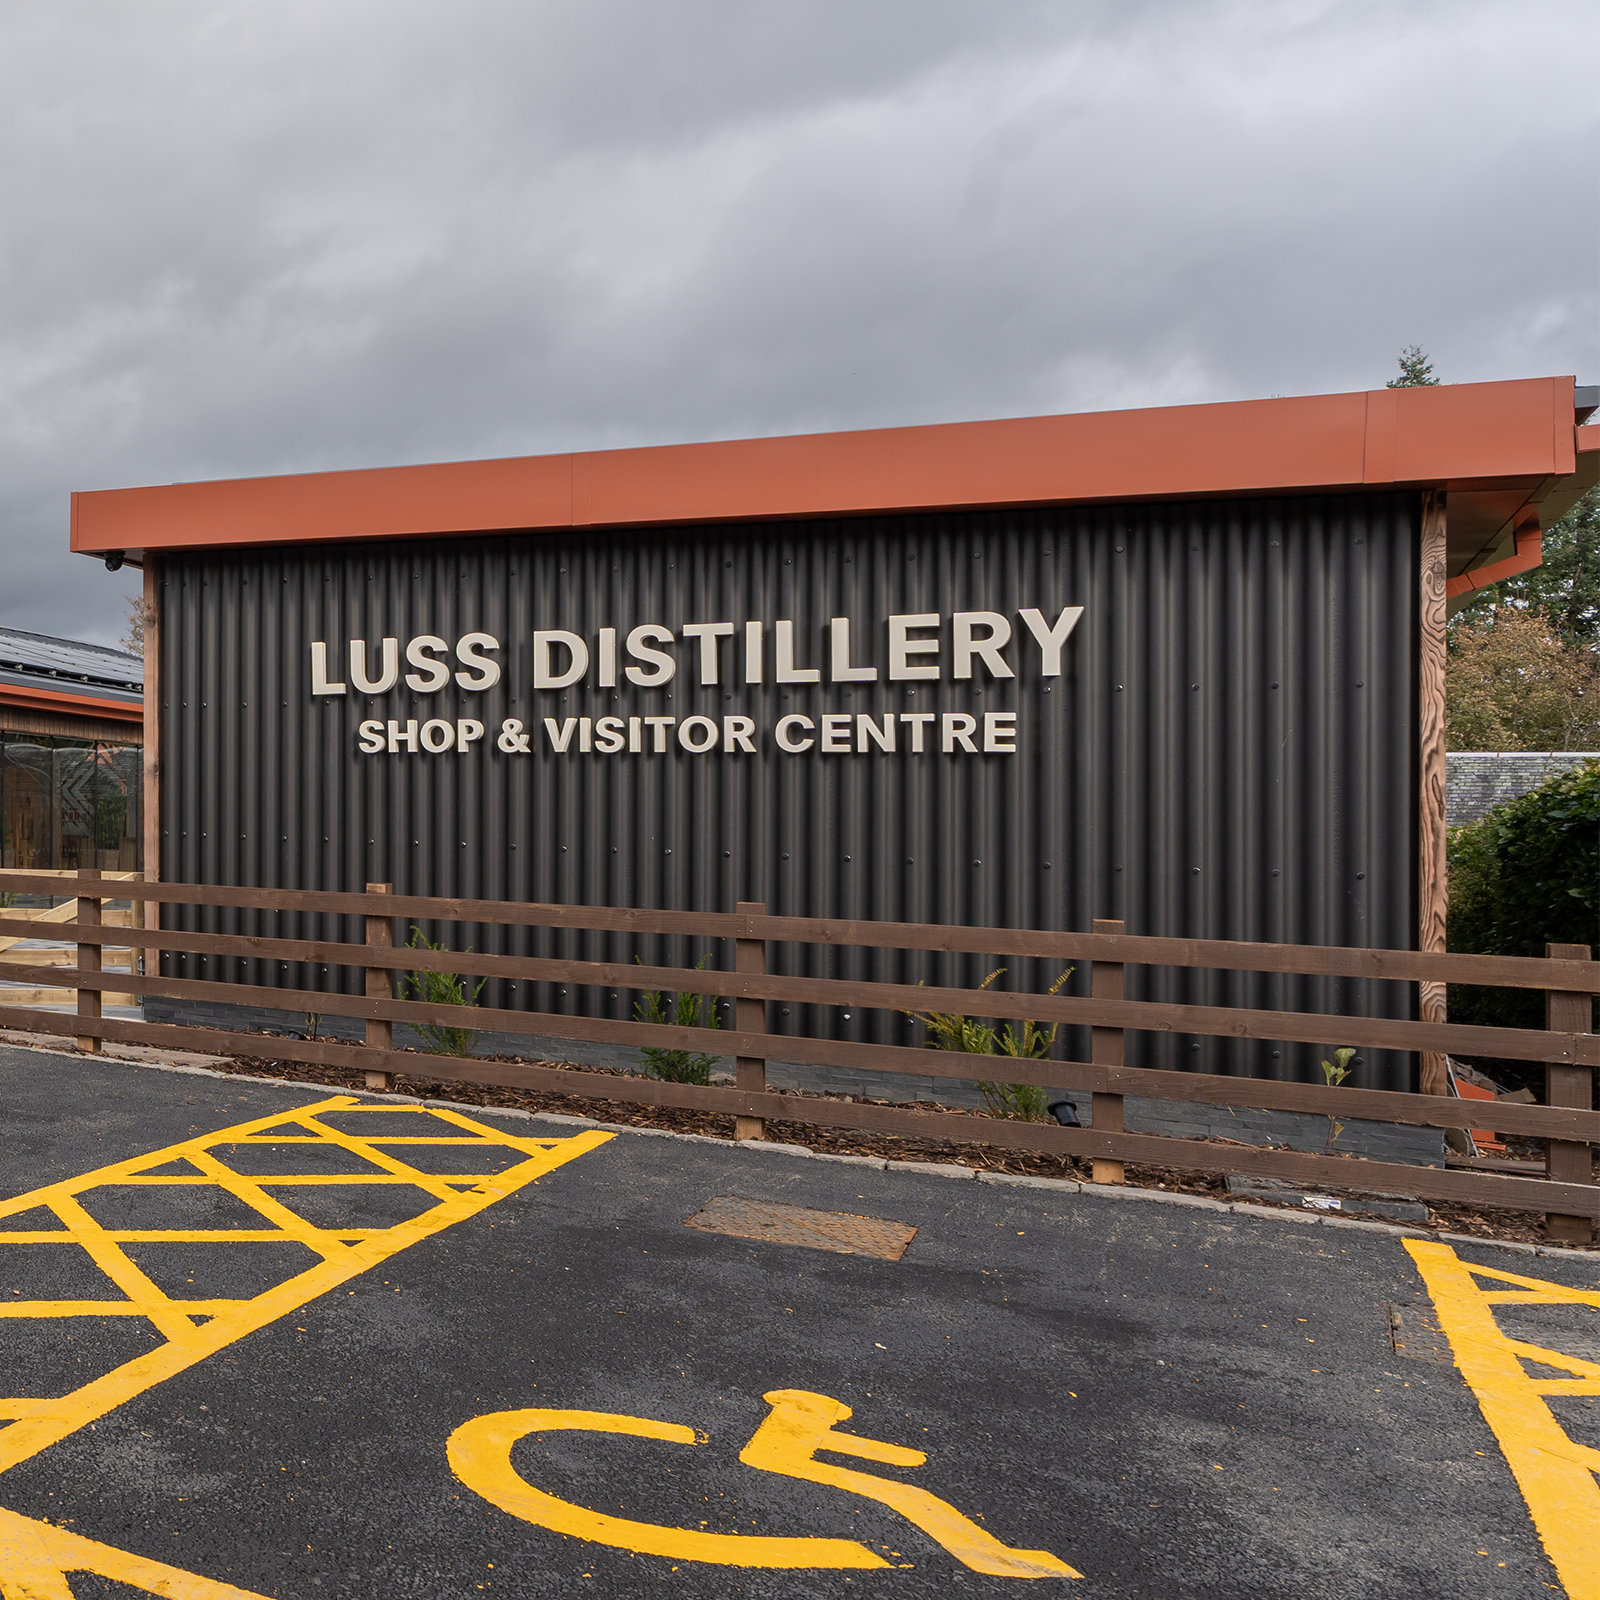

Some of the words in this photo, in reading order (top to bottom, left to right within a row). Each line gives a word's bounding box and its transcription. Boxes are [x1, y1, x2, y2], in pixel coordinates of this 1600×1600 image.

[311, 632, 500, 695] LUSS
[533, 606, 1084, 689] DISTILLERY
[358, 719, 485, 754] SHOP
[497, 718, 532, 754] &
[544, 714, 757, 754] VISITOR
[774, 712, 1018, 754] CENTRE
